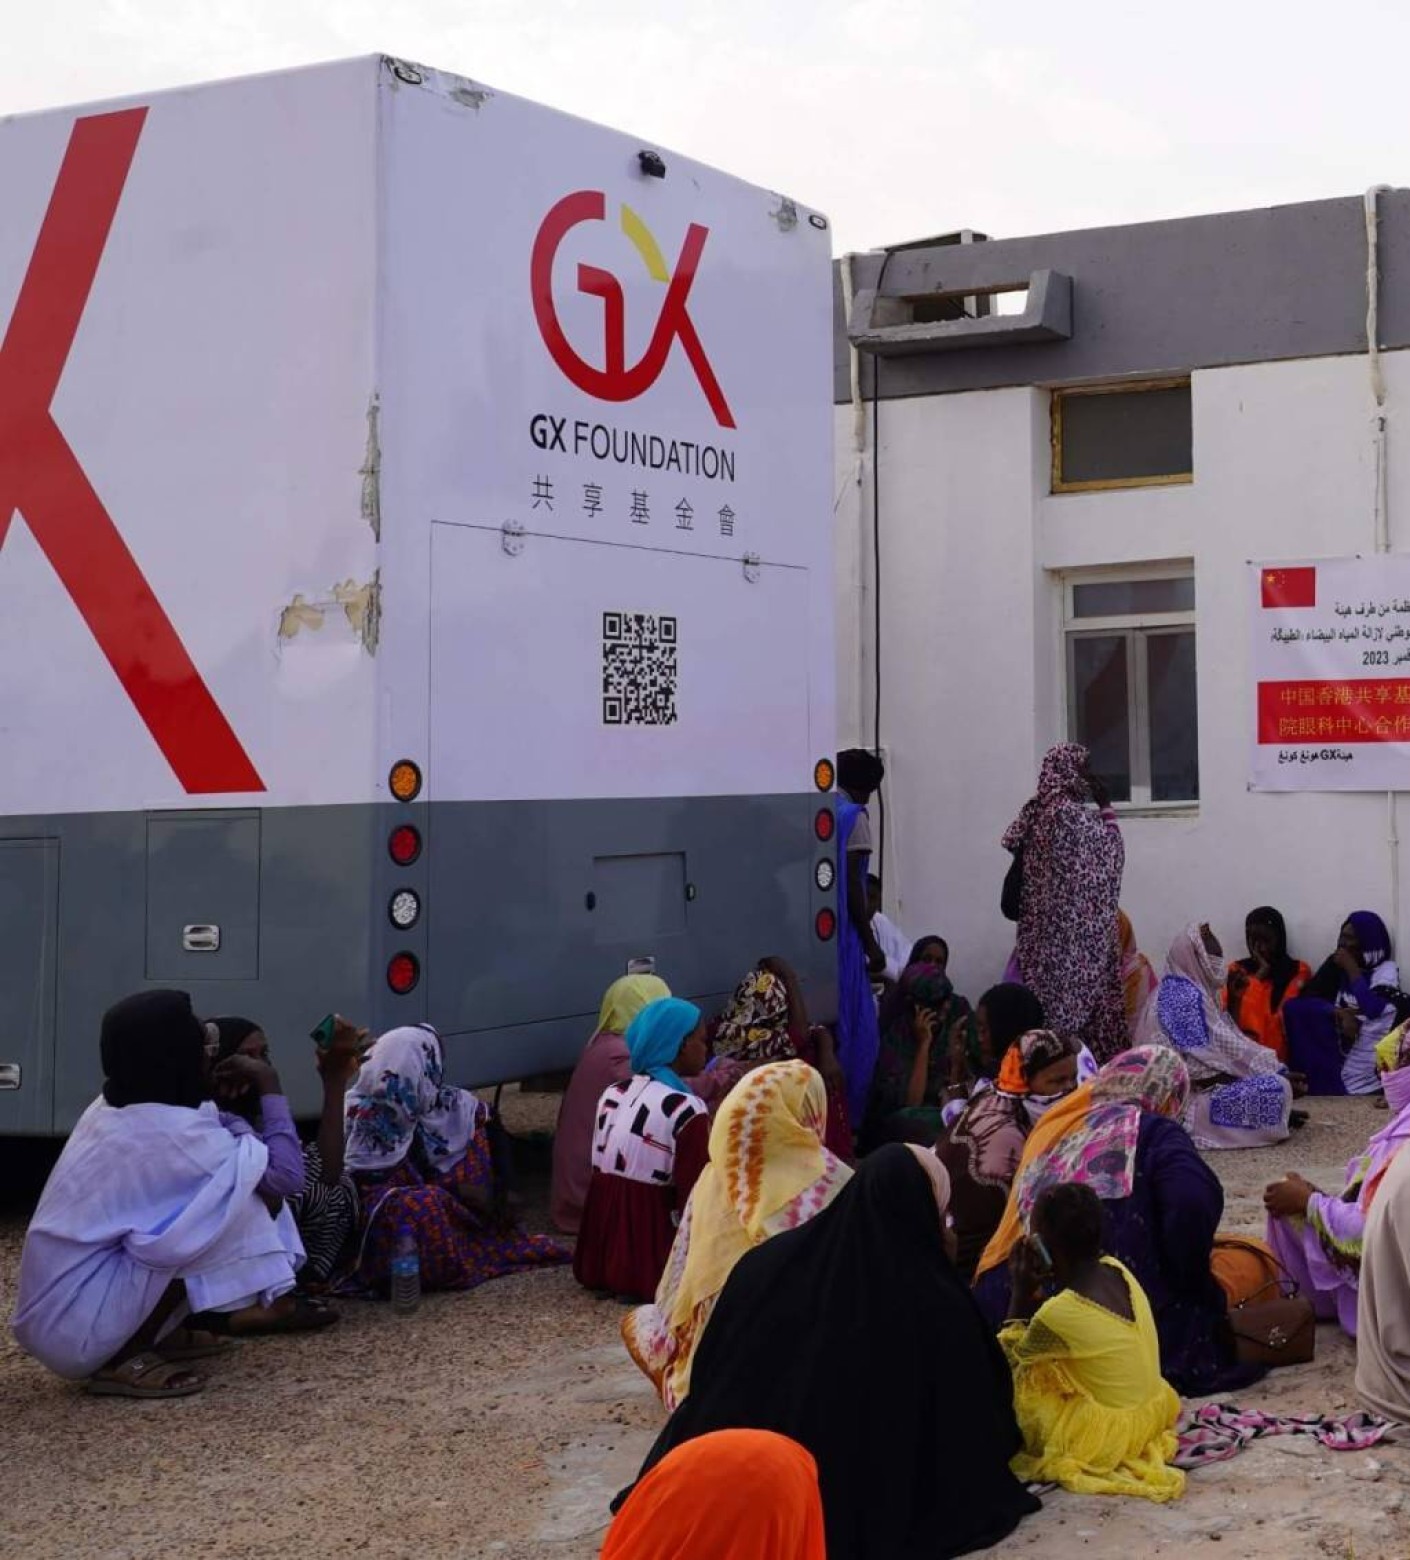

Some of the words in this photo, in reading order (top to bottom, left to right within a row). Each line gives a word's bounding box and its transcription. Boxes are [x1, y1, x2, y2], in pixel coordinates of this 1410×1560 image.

[530, 190, 737, 430] GX
[529, 413, 567, 453] GX
[574, 420, 736, 483] FOUNDATION
[532, 474, 736, 537] 共享基金會
[1355, 600, 1376, 617] طرف
[1378, 604, 1390, 617] من
[1362, 650, 1389, 665] 2023
